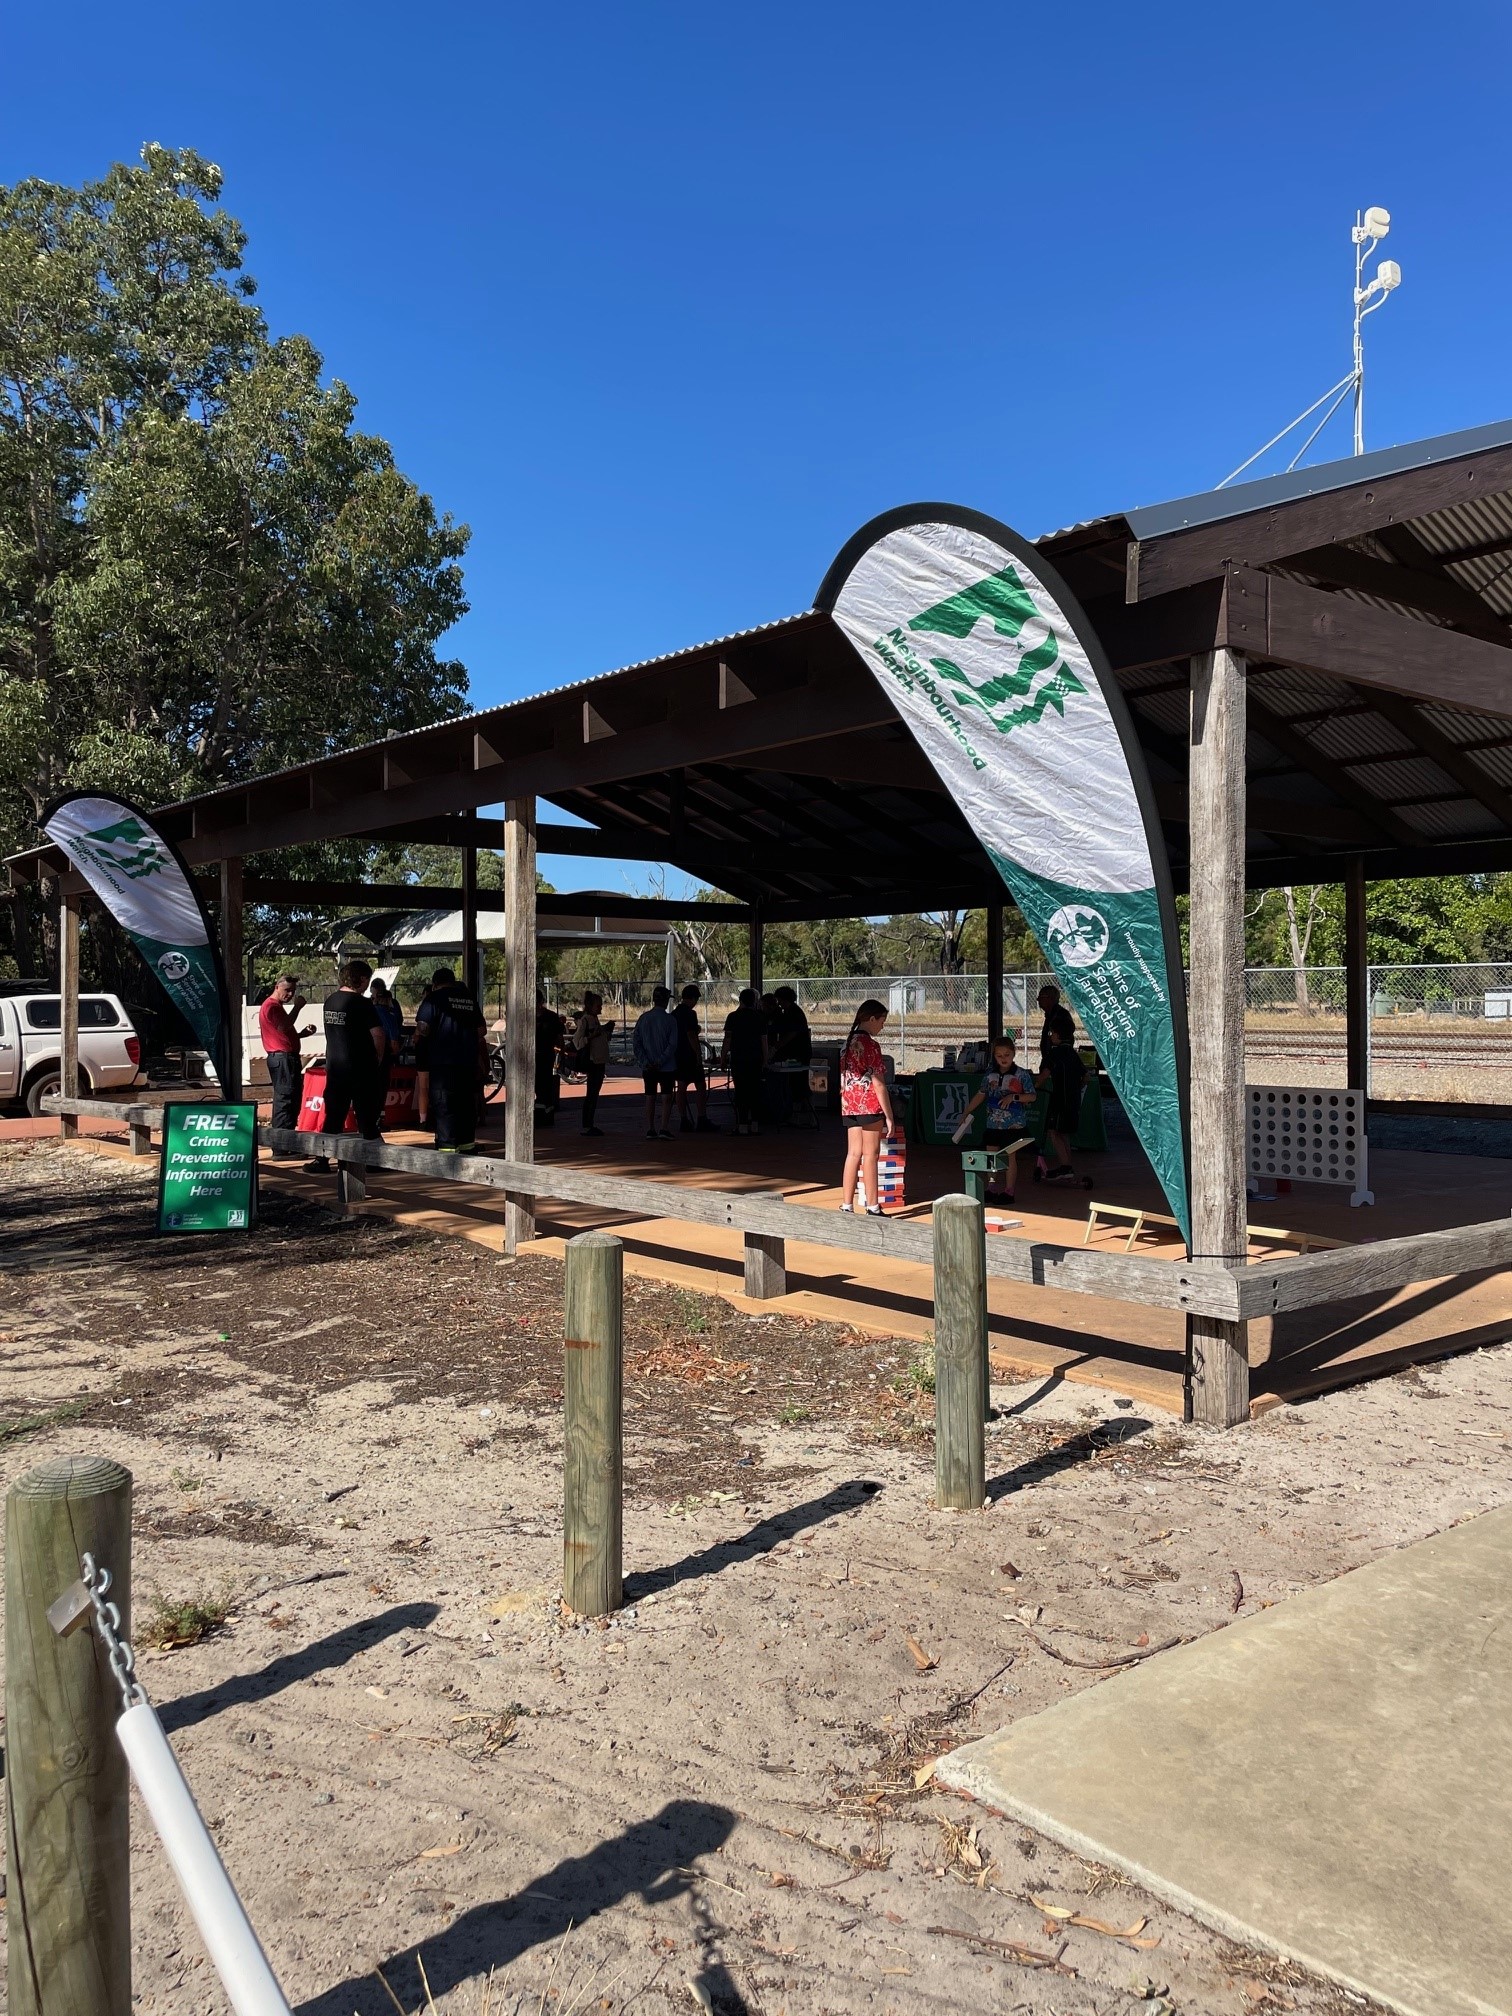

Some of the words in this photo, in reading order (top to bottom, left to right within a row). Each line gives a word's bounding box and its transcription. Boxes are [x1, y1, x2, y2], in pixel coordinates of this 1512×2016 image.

[872, 636, 915, 696] Watch
[886, 626, 988, 771] Neighbourhood
[67, 839, 89, 863] Watch
[73, 836, 126, 895] Neighbourhood
[1105, 959, 1130, 994] Shire
[1125, 995, 1142, 1011] of
[1123, 931, 1142, 958] Proudly
[1137, 957, 1162, 993] supported
[1157, 990, 1167, 1002] by
[1075, 975, 1120, 1040] Jarrahdale
[1092, 965, 1137, 1039] Serpentine
[182, 1114, 239, 1131] FREE
[189, 1135, 229, 1147] Crime
[165, 1168, 248, 1183] Information
[170, 1152, 245, 1164] Prevention
[189, 1185, 223, 1197] Here
